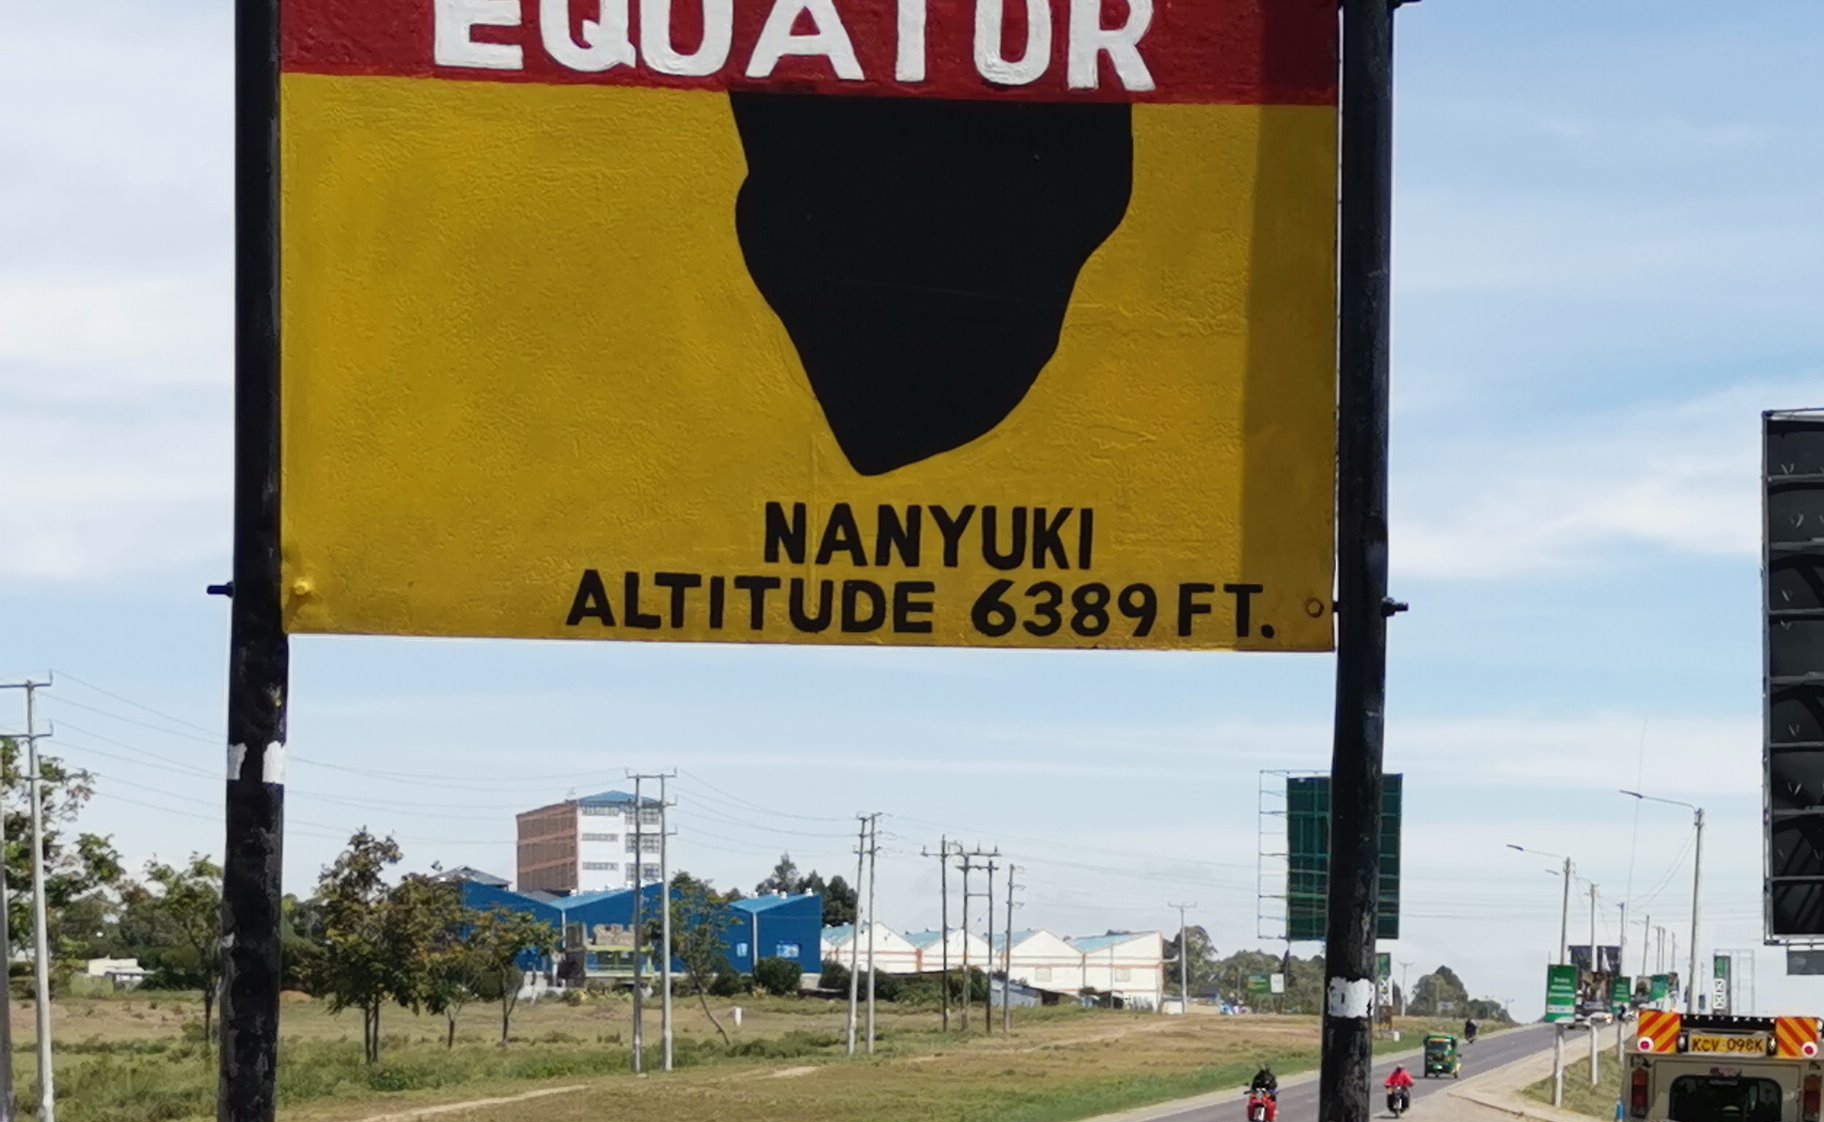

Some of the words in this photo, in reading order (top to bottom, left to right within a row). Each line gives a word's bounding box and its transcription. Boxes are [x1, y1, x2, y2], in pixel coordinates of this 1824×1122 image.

[763, 500, 1095, 571] NANYUKI
[566, 568, 936, 634] ALTITUDE
[970, 578, 1157, 639] 6389
[1176, 581, 1277, 640] FT.
[1691, 1038, 1718, 1052] KCV
